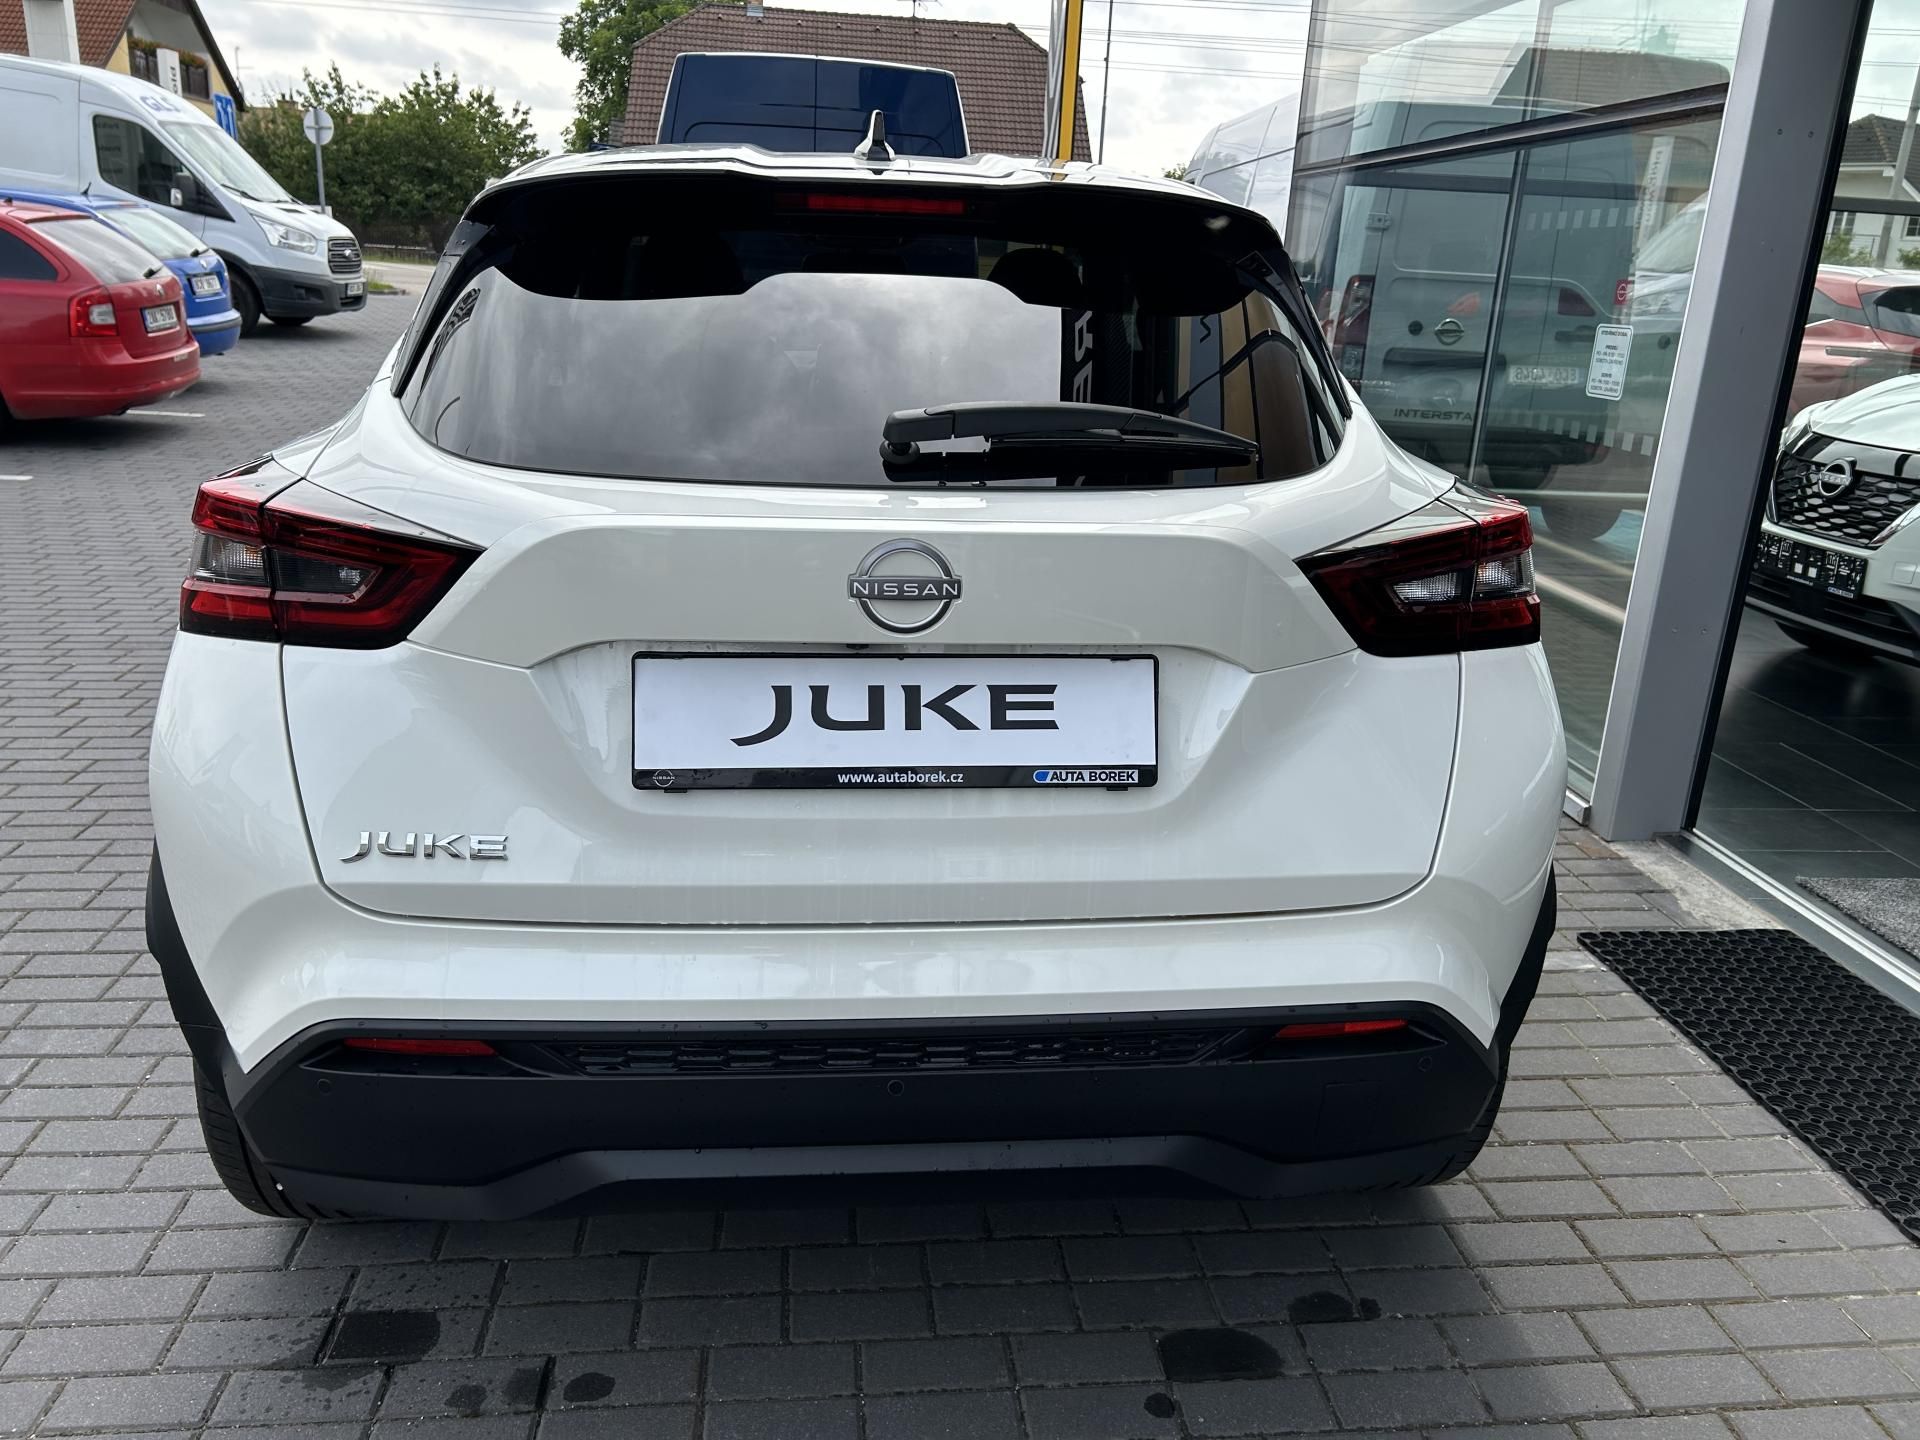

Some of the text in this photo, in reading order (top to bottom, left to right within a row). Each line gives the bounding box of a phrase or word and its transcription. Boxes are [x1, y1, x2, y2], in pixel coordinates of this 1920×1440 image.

[1394, 408, 1473, 422] INTERSTA
[853, 582, 958, 596] NISSAN
[730, 684, 1060, 747] JUKE
[837, 771, 964, 784] www.autaborek.cz
[1050, 770, 1136, 783] AUTA BOREK
[338, 831, 509, 864] JUKE
